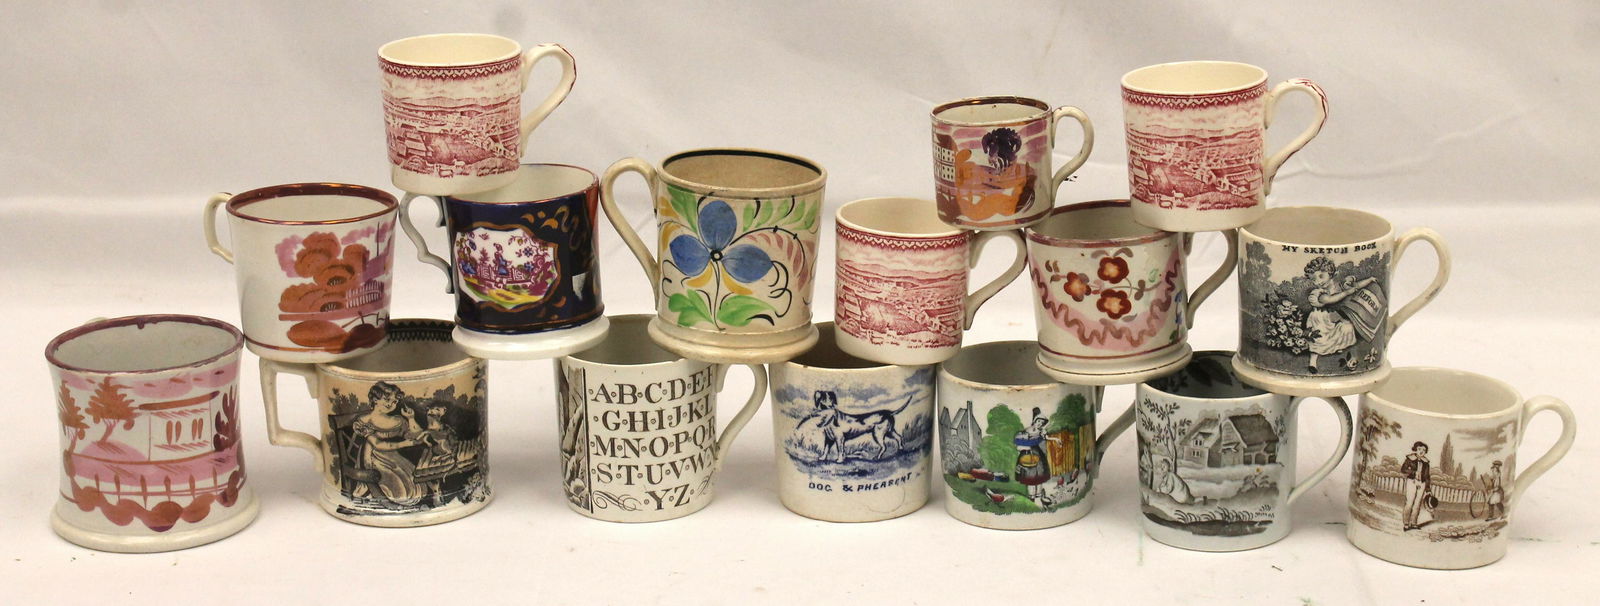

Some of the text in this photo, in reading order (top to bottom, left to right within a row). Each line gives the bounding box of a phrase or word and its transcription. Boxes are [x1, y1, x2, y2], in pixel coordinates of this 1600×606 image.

[1281, 241, 1378, 254] MY SKETCH BOOK
[808, 482, 833, 492] DOG
[842, 484, 854, 492] &
